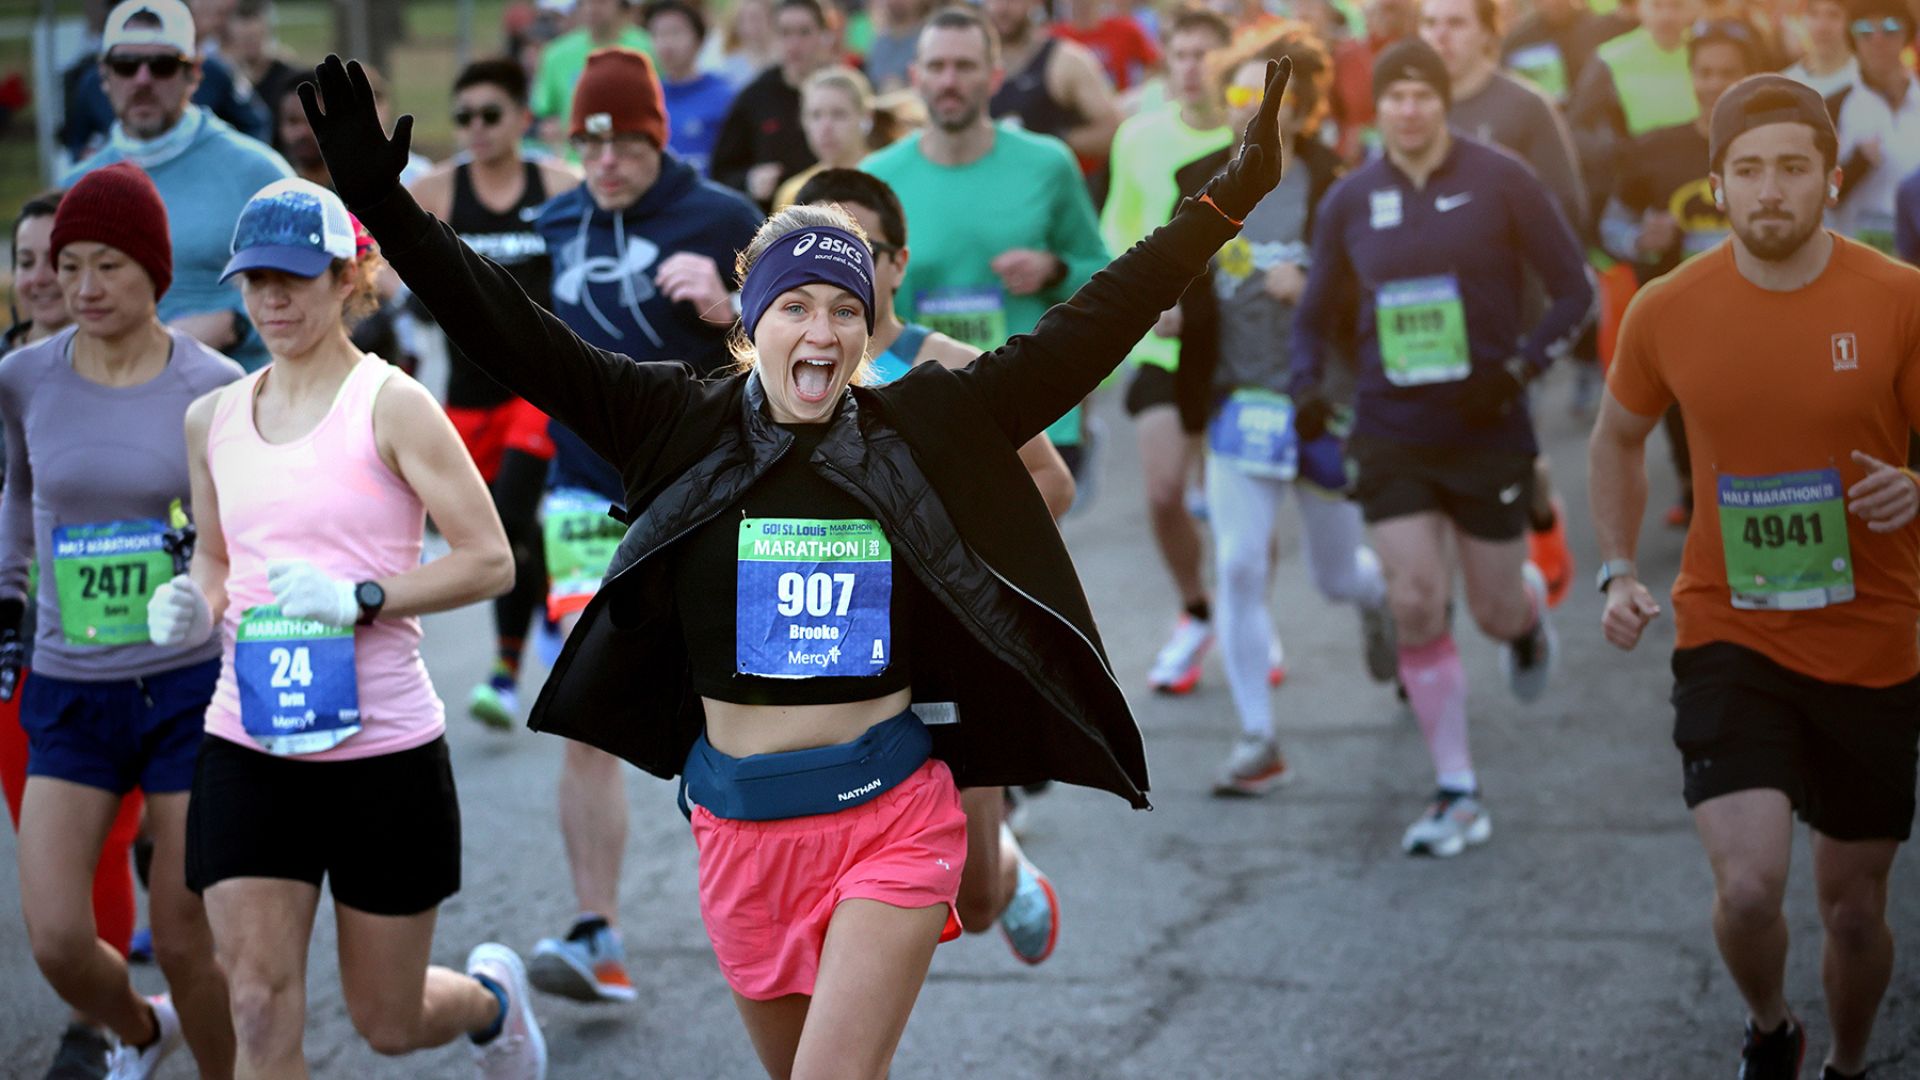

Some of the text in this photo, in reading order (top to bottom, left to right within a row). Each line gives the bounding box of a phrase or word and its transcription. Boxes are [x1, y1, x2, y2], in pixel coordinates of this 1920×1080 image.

[819, 236, 863, 265] asics
[1721, 490, 1750, 505] HALF
[1752, 486, 1818, 506] MARATHON
[762, 523, 828, 537] GO! St. Louis
[829, 523, 873, 531] MARATHON
[1743, 511, 1824, 549] 4941
[753, 539, 859, 557] MARATHON
[78, 560, 148, 600] 2477
[777, 571, 856, 617] 907
[244, 619, 324, 637] MARATHON
[789, 624, 839, 640] Brooke
[788, 650, 831, 668] Mercy
[871, 639, 884, 659] A
[269, 646, 313, 688] 24
[272, 714, 307, 730] Mercy
[838, 778, 882, 801] NATHAN
